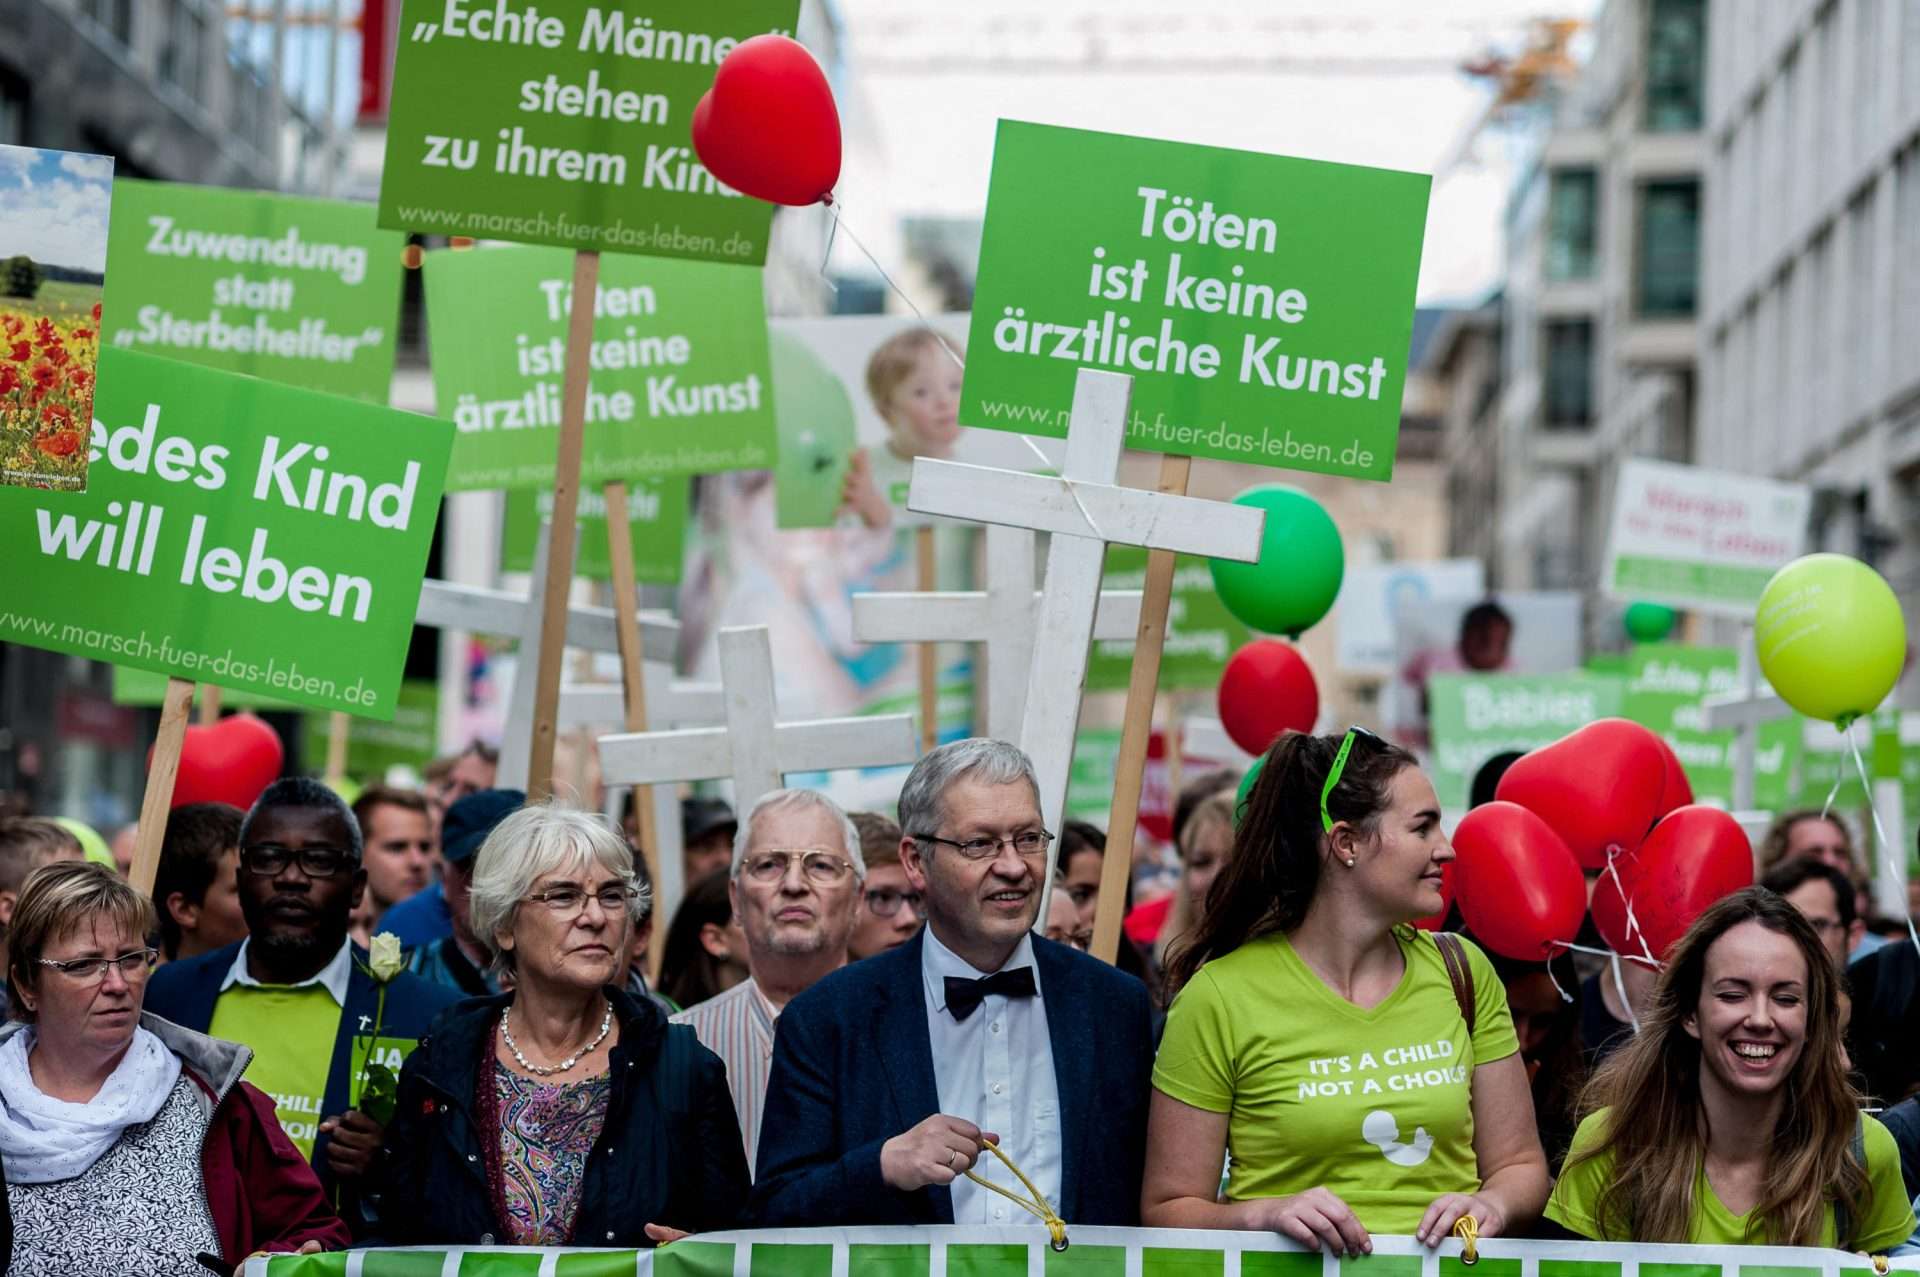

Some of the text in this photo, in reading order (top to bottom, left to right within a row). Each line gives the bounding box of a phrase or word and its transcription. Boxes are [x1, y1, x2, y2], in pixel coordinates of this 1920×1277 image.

[577, 9, 790, 66] Männe
[519, 70, 669, 125] stehen
[421, 127, 744, 198] zu ihrem Kin
[399, 204, 753, 257] www.marsch-fuer-das-leben.de
[1137, 186, 1278, 253] Töten
[146, 215, 368, 285] Zuwendung
[213, 273, 295, 311] statt
[1088, 246, 1308, 323] ist keine
[113, 304, 384, 362] „Sterbehelfer“
[516, 334, 565, 376] ist
[993, 306, 1387, 401] ärztliche Kunst
[453, 374, 762, 433] ärztlihe Kunst
[88, 404, 421, 531] edes Kind
[36, 500, 373, 622] will leben
[1358, 1053, 1379, 1070] A
[1383, 1039, 1454, 1066] CHILD
[268, 1092, 323, 1115] HIL
[1298, 1081, 1354, 1100] NOT
[1362, 1079, 1383, 1094] A
